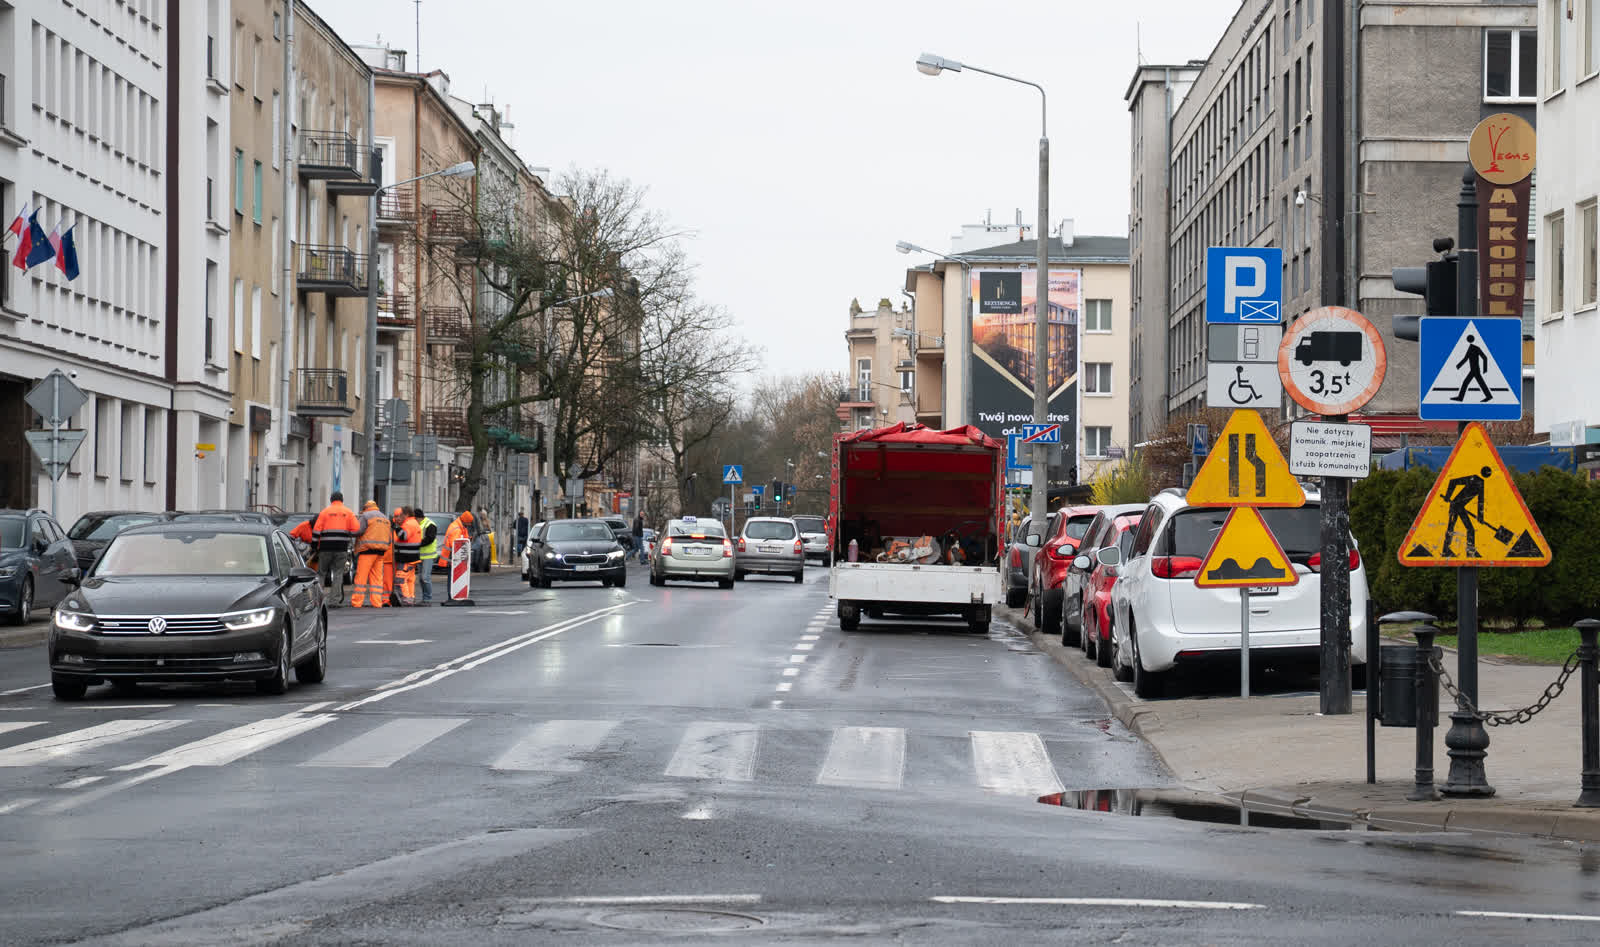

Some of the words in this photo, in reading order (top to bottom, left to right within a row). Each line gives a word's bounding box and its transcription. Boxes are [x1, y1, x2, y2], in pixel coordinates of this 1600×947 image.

[1489, 188, 1518, 315] ALKOHOL
[1224, 256, 1267, 314] P
[1309, 370, 1351, 398] 3,5t
[979, 412, 1005, 423] Twój
[1007, 414, 1035, 423] nowy
[1047, 412, 1070, 422] dres
[1002, 427, 1016, 436] od
[1023, 426, 1059, 441] TAXI
[1306, 426, 1319, 434] Nie
[1324, 427, 1354, 437] dotyczy
[1295, 437, 1328, 445] komunik.
[1331, 438, 1366, 448] miejskiej
[1305, 450, 1356, 459] zaopatrzenia
[1318, 461, 1368, 471] komunalnych
